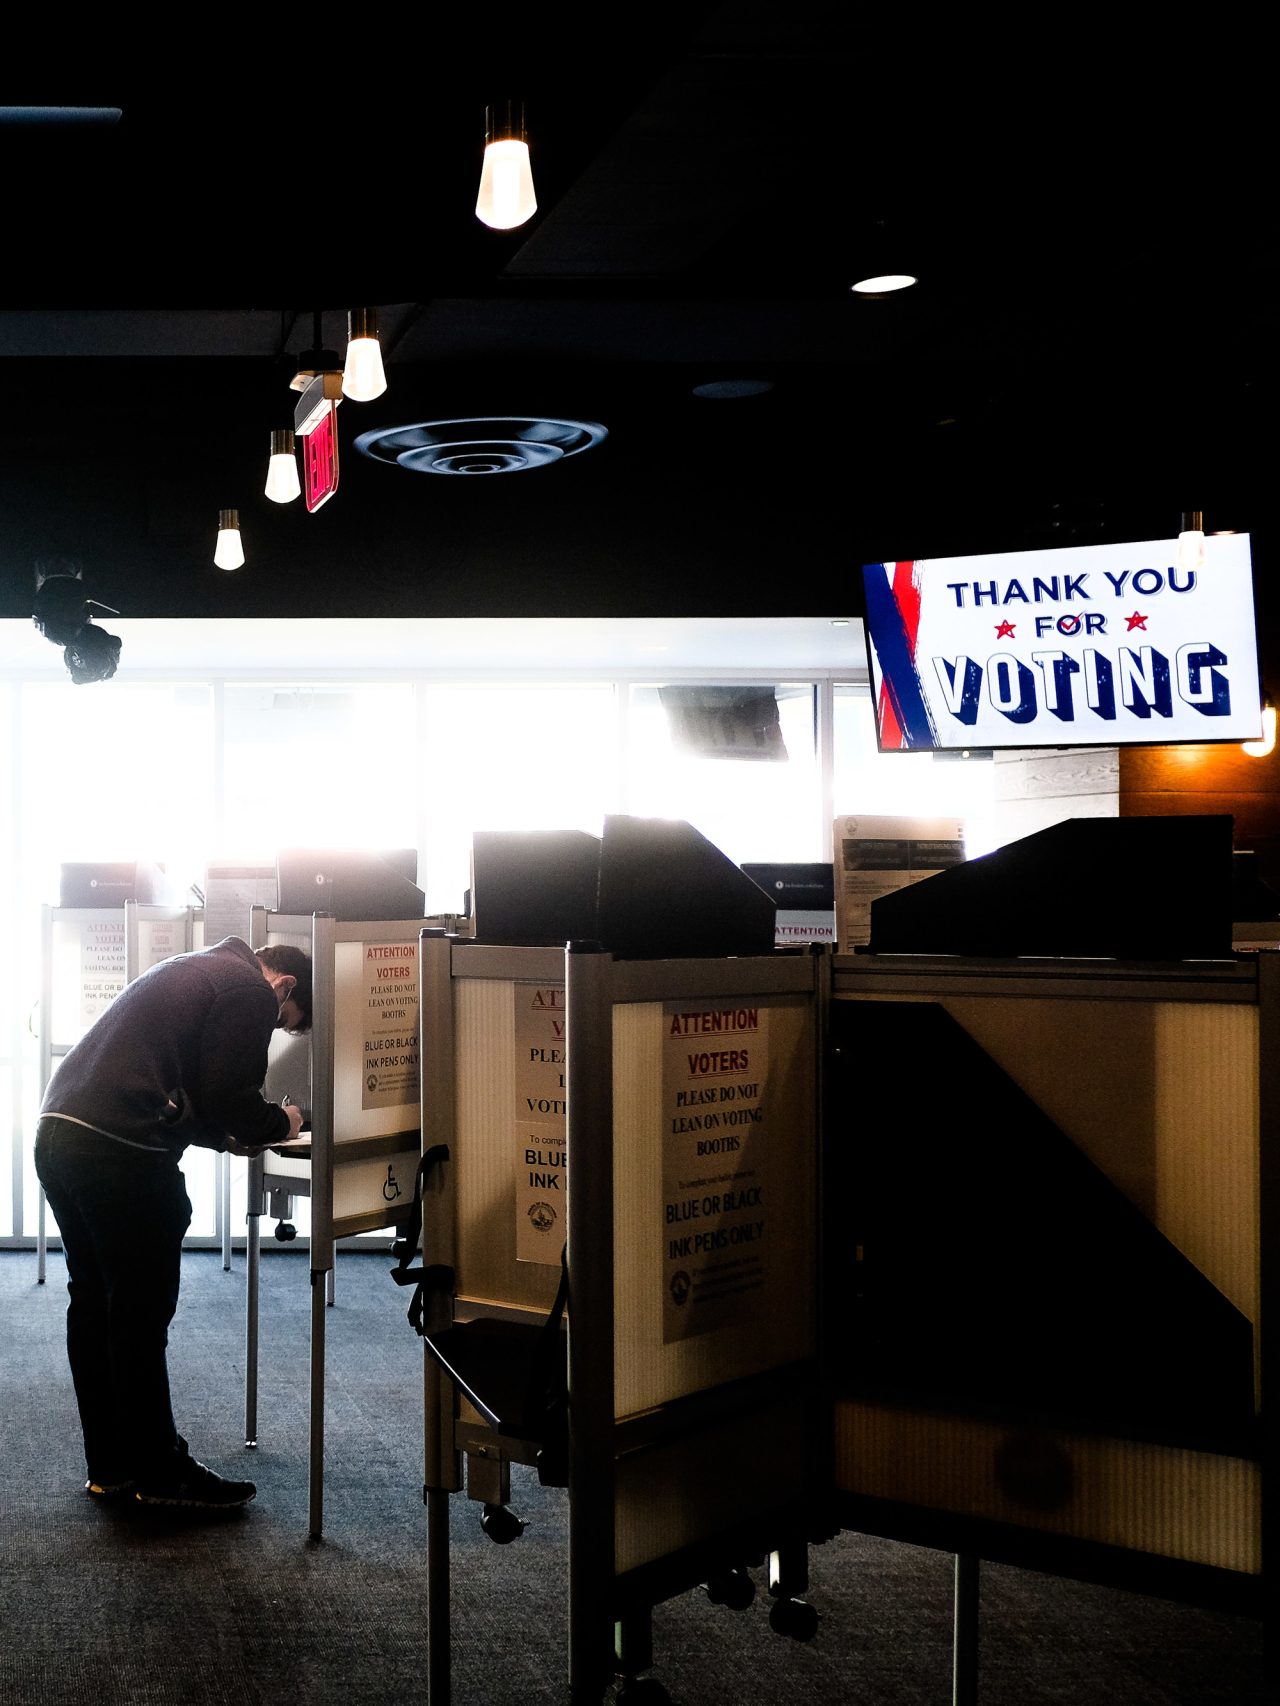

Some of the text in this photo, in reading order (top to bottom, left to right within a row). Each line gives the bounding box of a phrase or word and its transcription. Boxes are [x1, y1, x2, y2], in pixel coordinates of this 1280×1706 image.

[947, 566, 1198, 608] THANK YOU
[1035, 612, 1108, 638] FOR
[932, 641, 1232, 726] VOTING
[774, 926, 833, 936] ATTENTION
[367, 946, 415, 959] ATTENTION
[376, 966, 410, 979] VOTERS
[370, 983, 416, 995] PLEASE DO NOT
[368, 996, 418, 1008] LEAN ON VOTING
[381, 1009, 407, 1020] BOOTHS
[670, 1008, 758, 1035] ATTENTION
[365, 1036, 418, 1051] BLUE OR BLACK
[366, 1054, 419, 1069] INK PENS ONLY
[687, 1049, 749, 1074] VOTERS
[676, 1083, 759, 1108] PLEASE DO NOT
[672, 1107, 762, 1134] LEAN ON VOTING
[529, 1134, 566, 1146] To compl
[697, 1135, 740, 1156] BOOTHS
[529, 1171, 560, 1190] INK
[665, 1187, 762, 1224] BLUE OR BLACK
[669, 1221, 764, 1260] INK PENS ONLY
